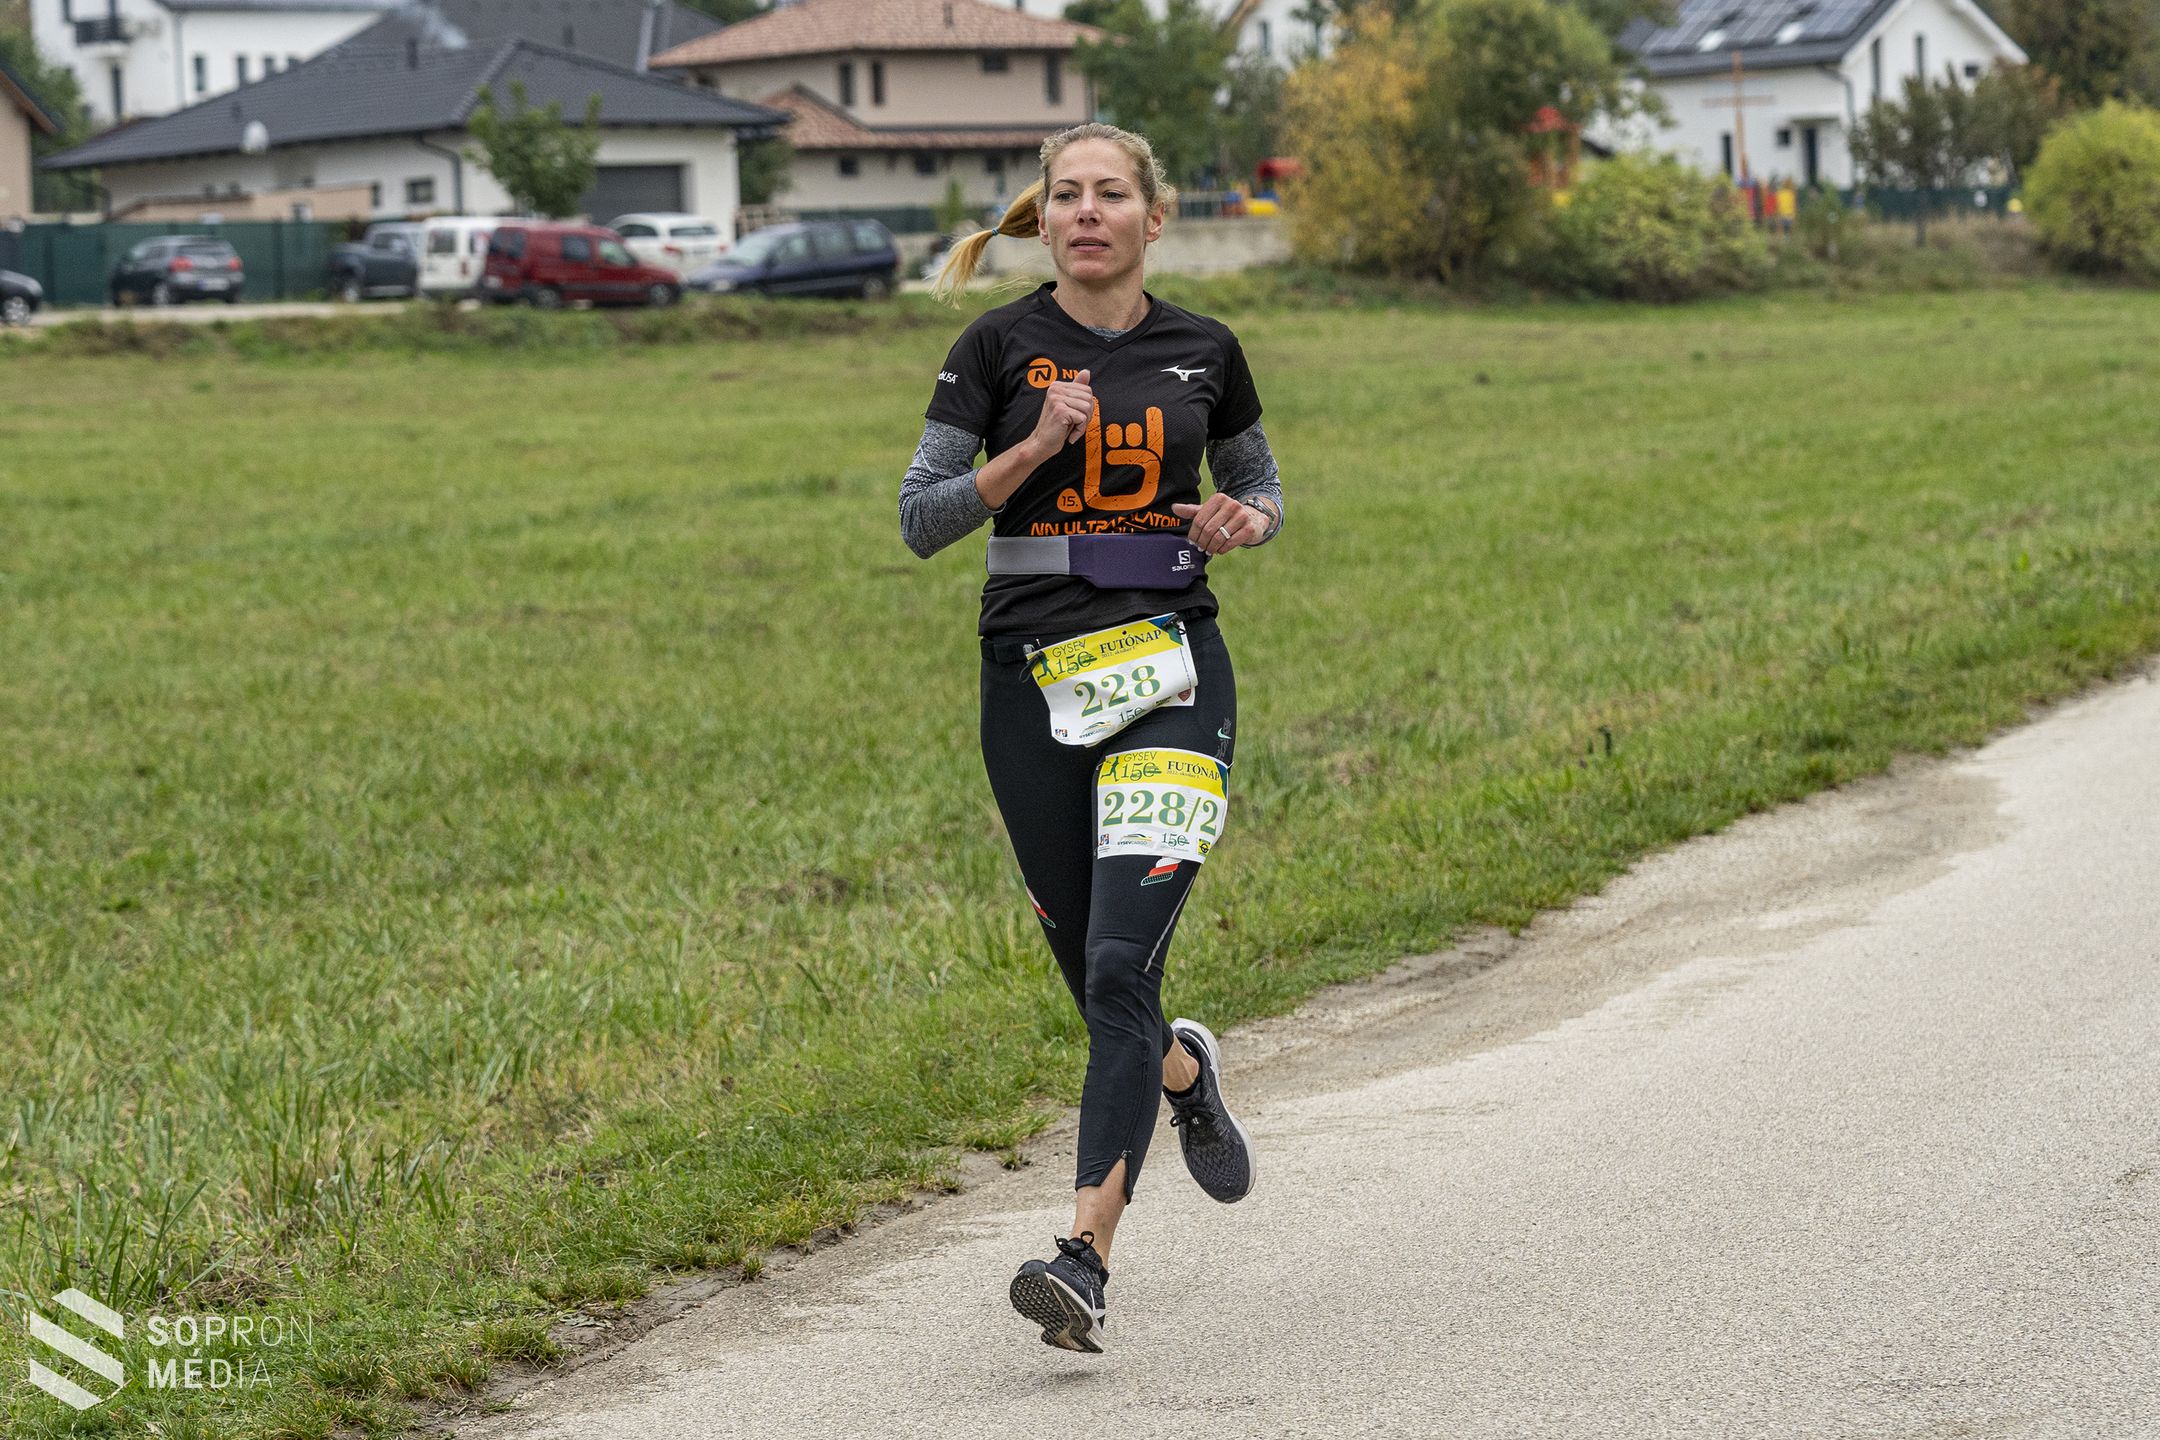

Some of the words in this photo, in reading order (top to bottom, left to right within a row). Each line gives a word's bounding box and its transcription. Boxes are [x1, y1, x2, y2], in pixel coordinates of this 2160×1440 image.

[1030, 522, 1059, 537] NN
[1052, 639, 1087, 658] GYSEV
[1100, 629, 1162, 653] FUTÓNAP
[1074, 665, 1161, 718] 228
[1123, 751, 1157, 762] GYSEV
[1168, 760, 1220, 780] FUTÓNAP
[1102, 789, 1219, 836] 228/2
